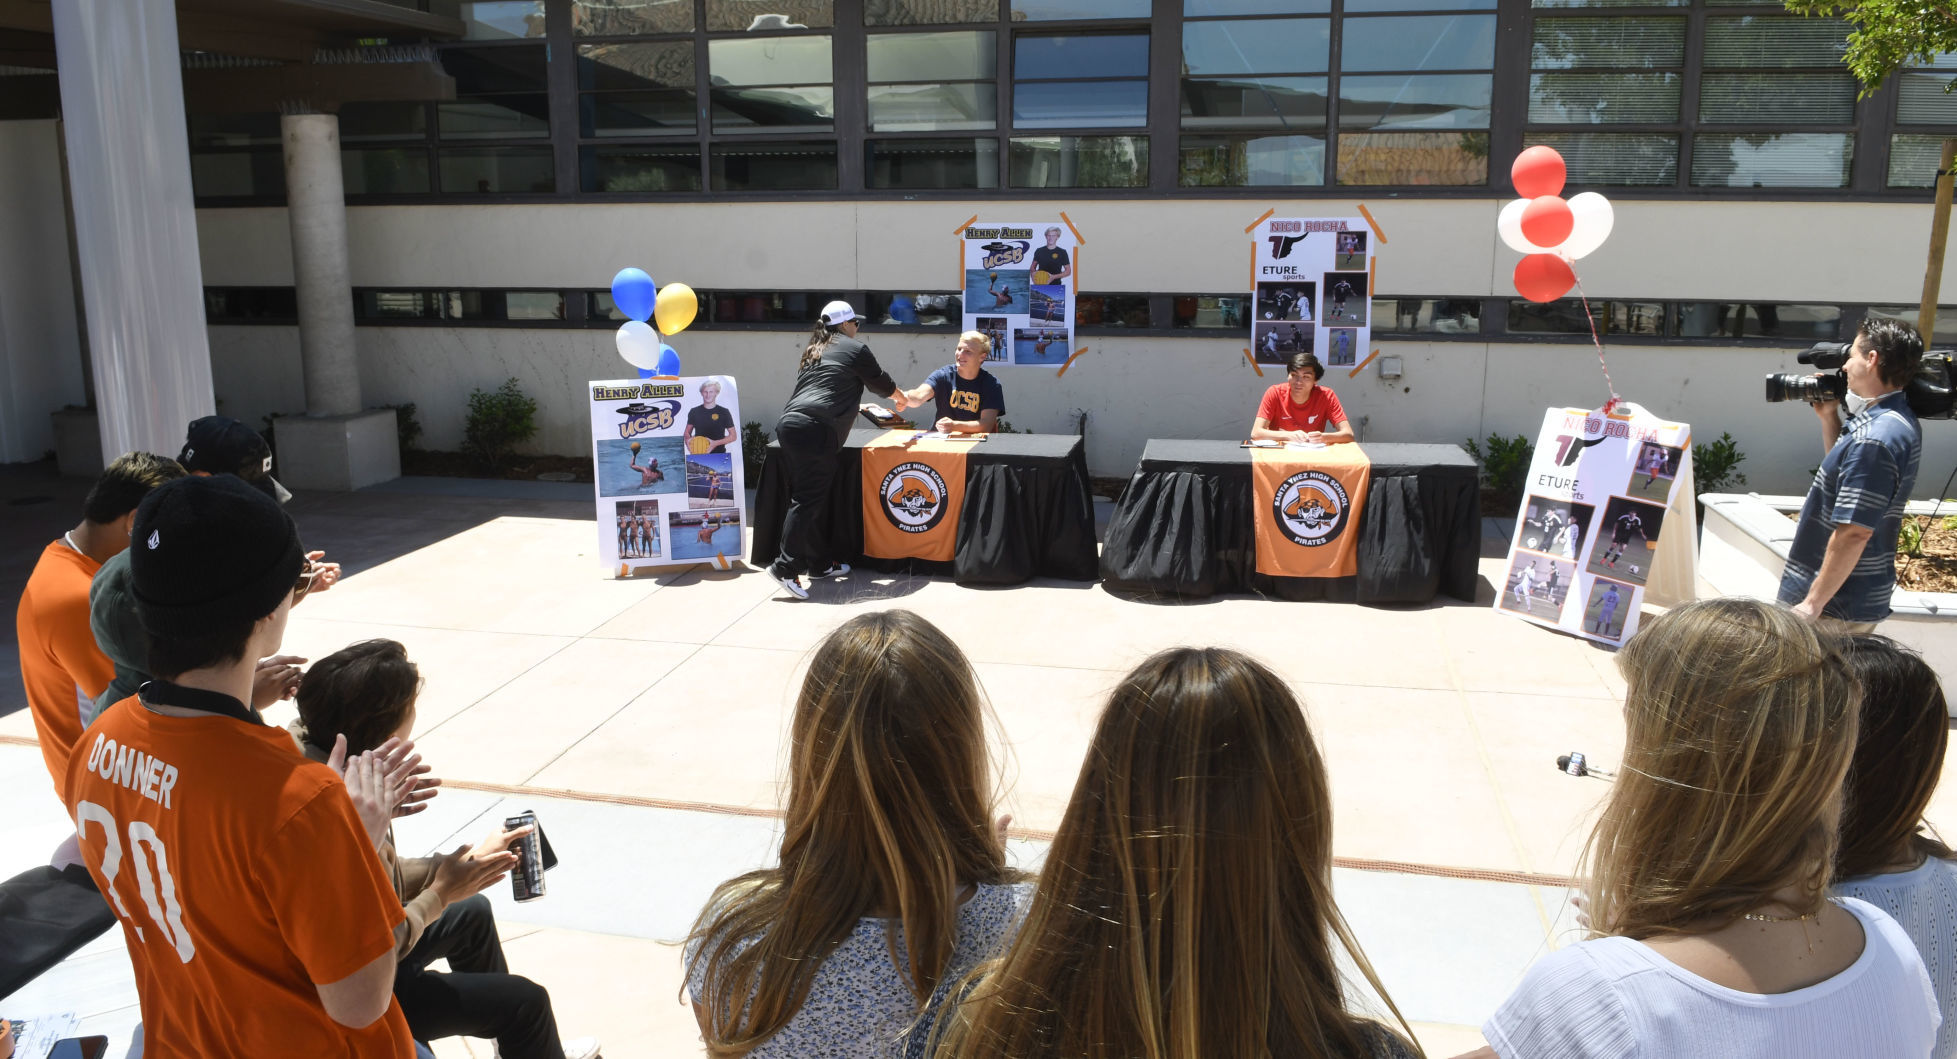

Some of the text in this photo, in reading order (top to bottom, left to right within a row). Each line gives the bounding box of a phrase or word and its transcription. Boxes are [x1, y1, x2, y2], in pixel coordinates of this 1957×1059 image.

[965, 227, 1033, 239] HENRY ALLEN
[1270, 221, 1349, 232] NICO ROCHA
[983, 247, 1023, 269] UCSB
[1262, 266, 1298, 274] ETURE
[593, 384, 684, 401] HENRY ALLEN
[618, 408, 674, 439] UCSB
[881, 463, 947, 497] SANTA YNEZ HIGH SCHOOL
[1538, 474, 1579, 491] ETURE
[1274, 472, 1349, 507] SANTA YNEZ HIGH SCHOOL
[899, 523, 928, 532] PIRATES
[1294, 536, 1327, 546] PIRATES
[87, 732, 179, 809] DONNER
[77, 800, 196, 964] 20
